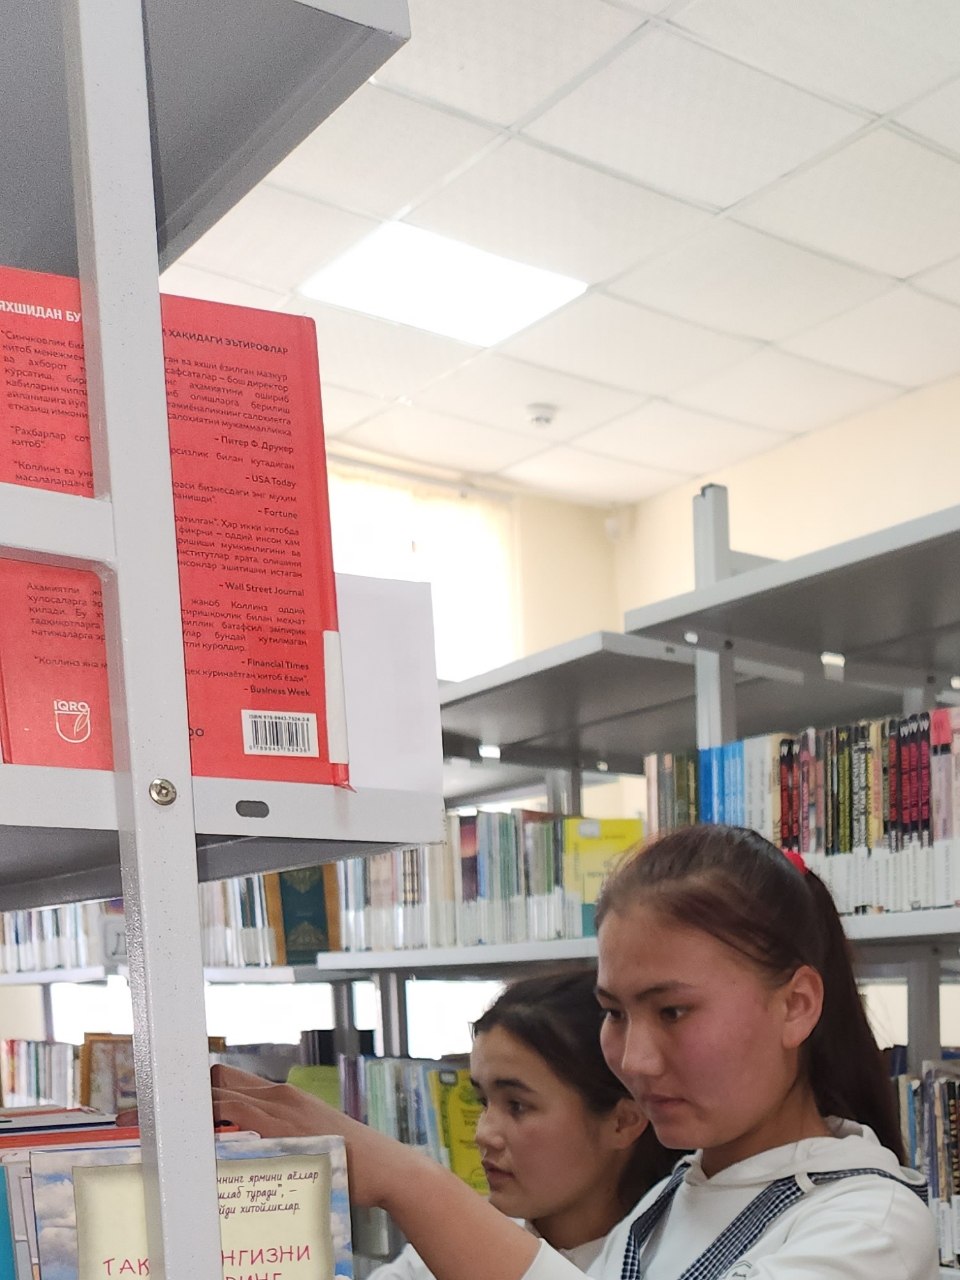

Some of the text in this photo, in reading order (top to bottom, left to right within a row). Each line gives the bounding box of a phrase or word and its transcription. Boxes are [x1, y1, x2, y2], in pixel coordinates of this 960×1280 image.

[225, 338, 289, 355] ЭЪТИРОФЛАР
[251, 474, 297, 490] USA Today
[263, 507, 298, 519] Fortune
[224, 581, 305, 597] Wall Street Journal
[246, 658, 309, 671] Financial Times
[250, 684, 311, 697] Business Week
[53, 700, 90, 712] IQRO
[248, 1173, 283, 1187] ярмини
[240, 1202, 301, 1215] хитойликлар
